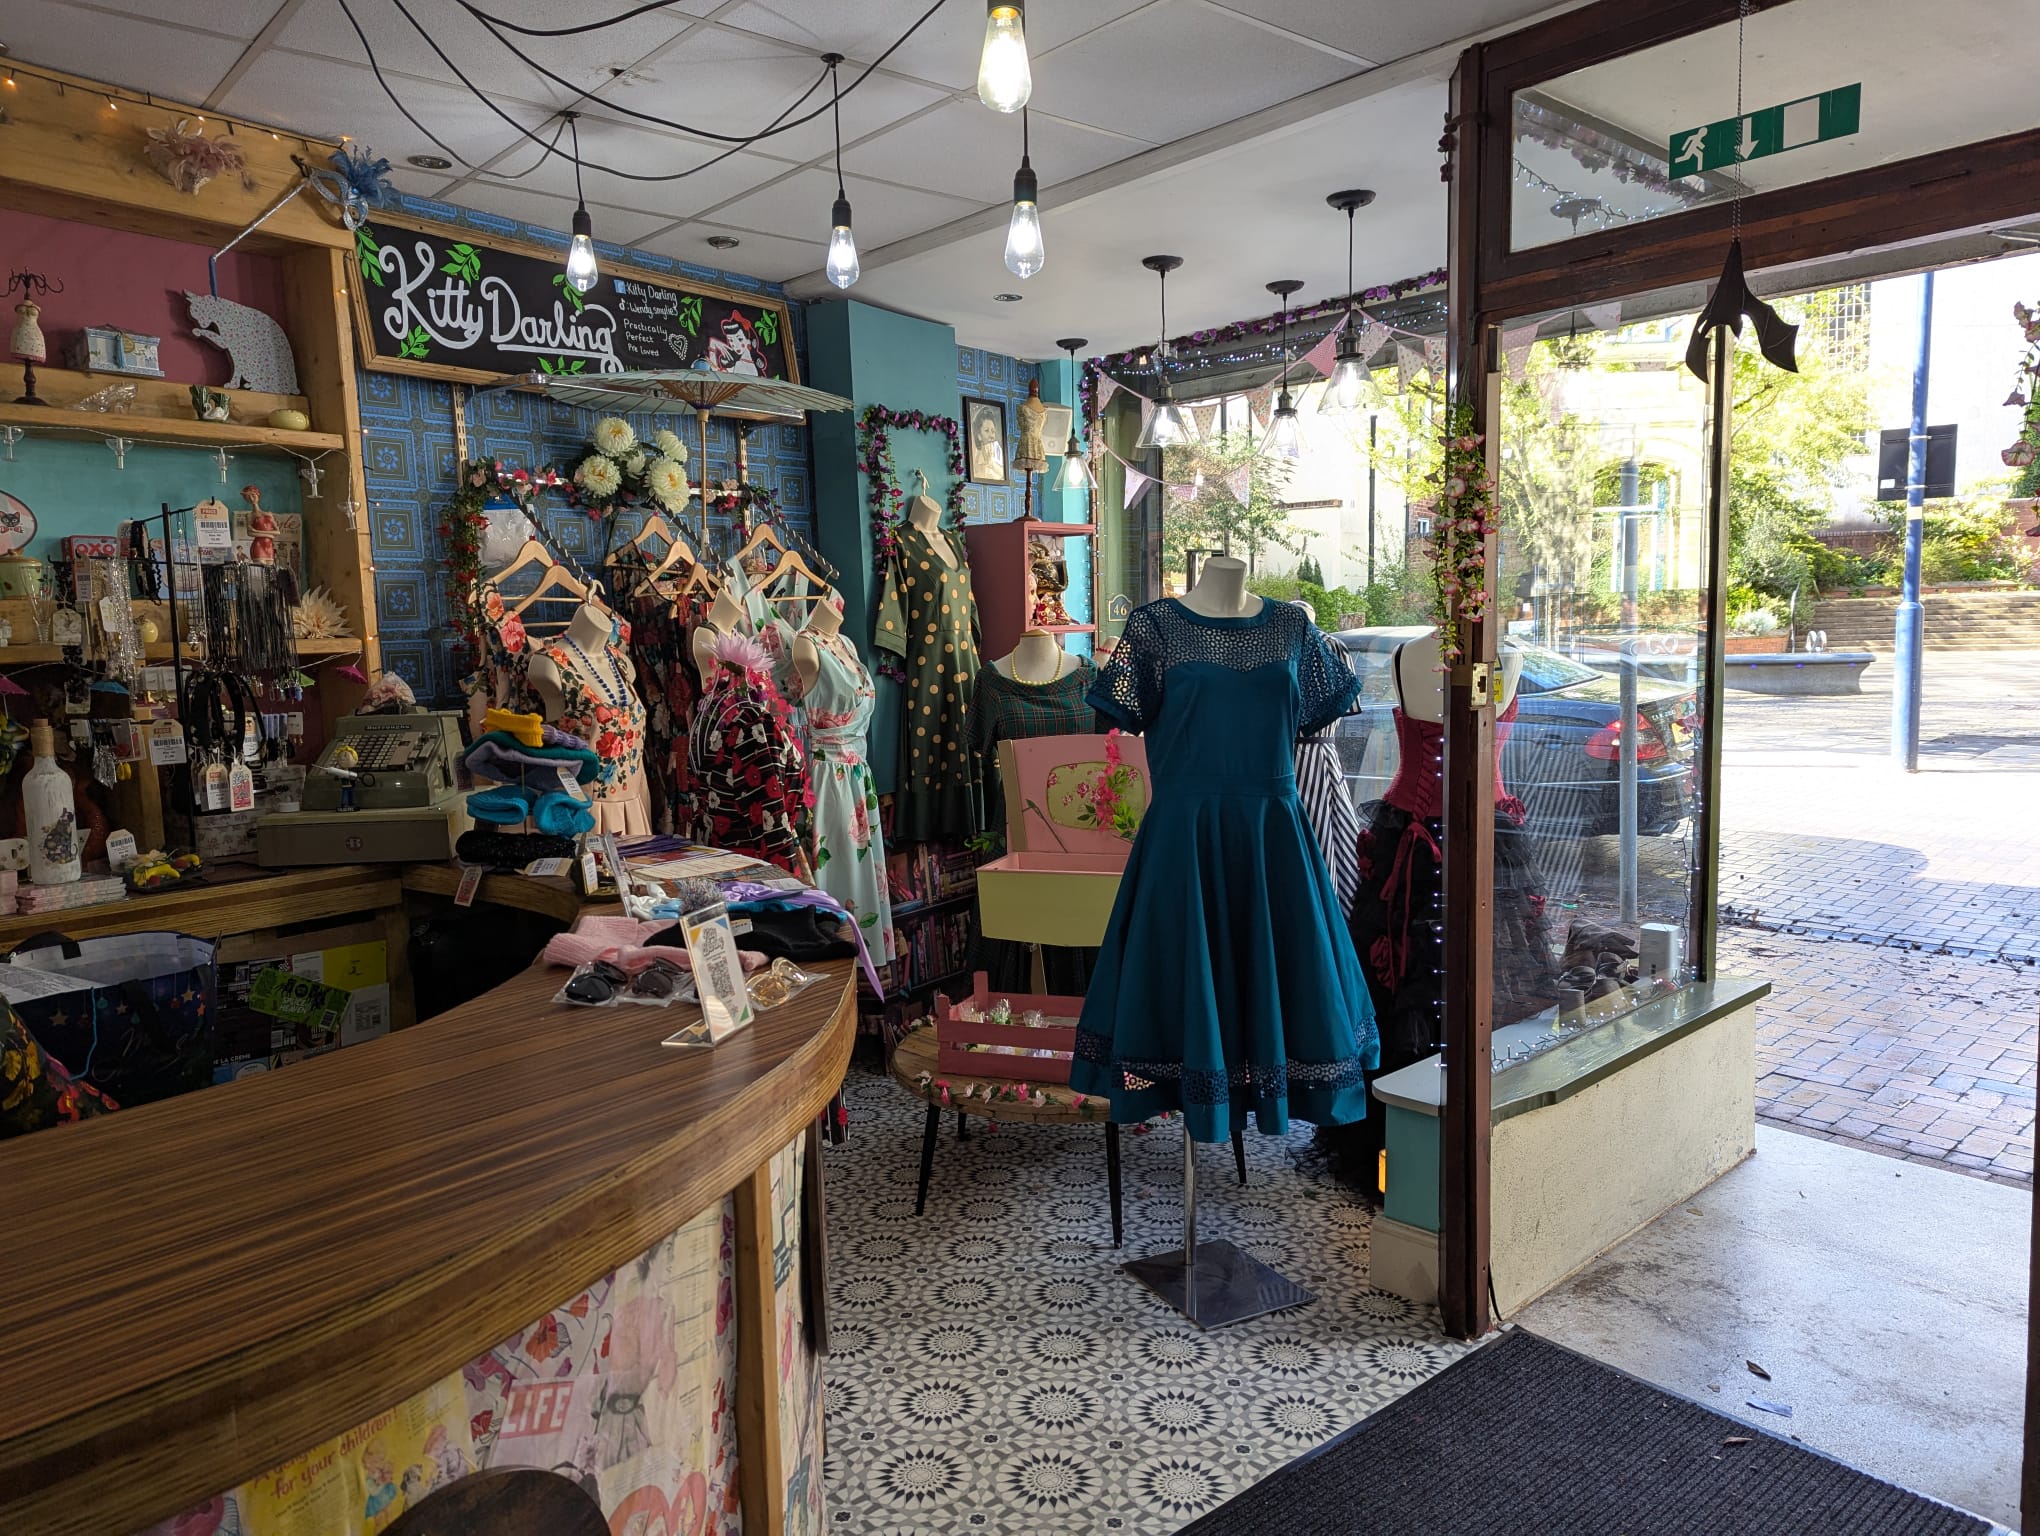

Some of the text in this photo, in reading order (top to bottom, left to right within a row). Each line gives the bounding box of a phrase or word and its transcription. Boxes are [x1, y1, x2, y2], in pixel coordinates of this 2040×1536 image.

[378, 241, 624, 372] Kitty Darling
[647, 285, 678, 308] Darling
[624, 318, 668, 341] Practically
[626, 331, 654, 343] Perfect
[628, 343, 660, 356] Pre loved
[76, 543, 116, 556] OXO
[1113, 603, 1128, 616] 46
[501, 1386, 571, 1434] LIFE
[300, 1453, 336, 1489] your
